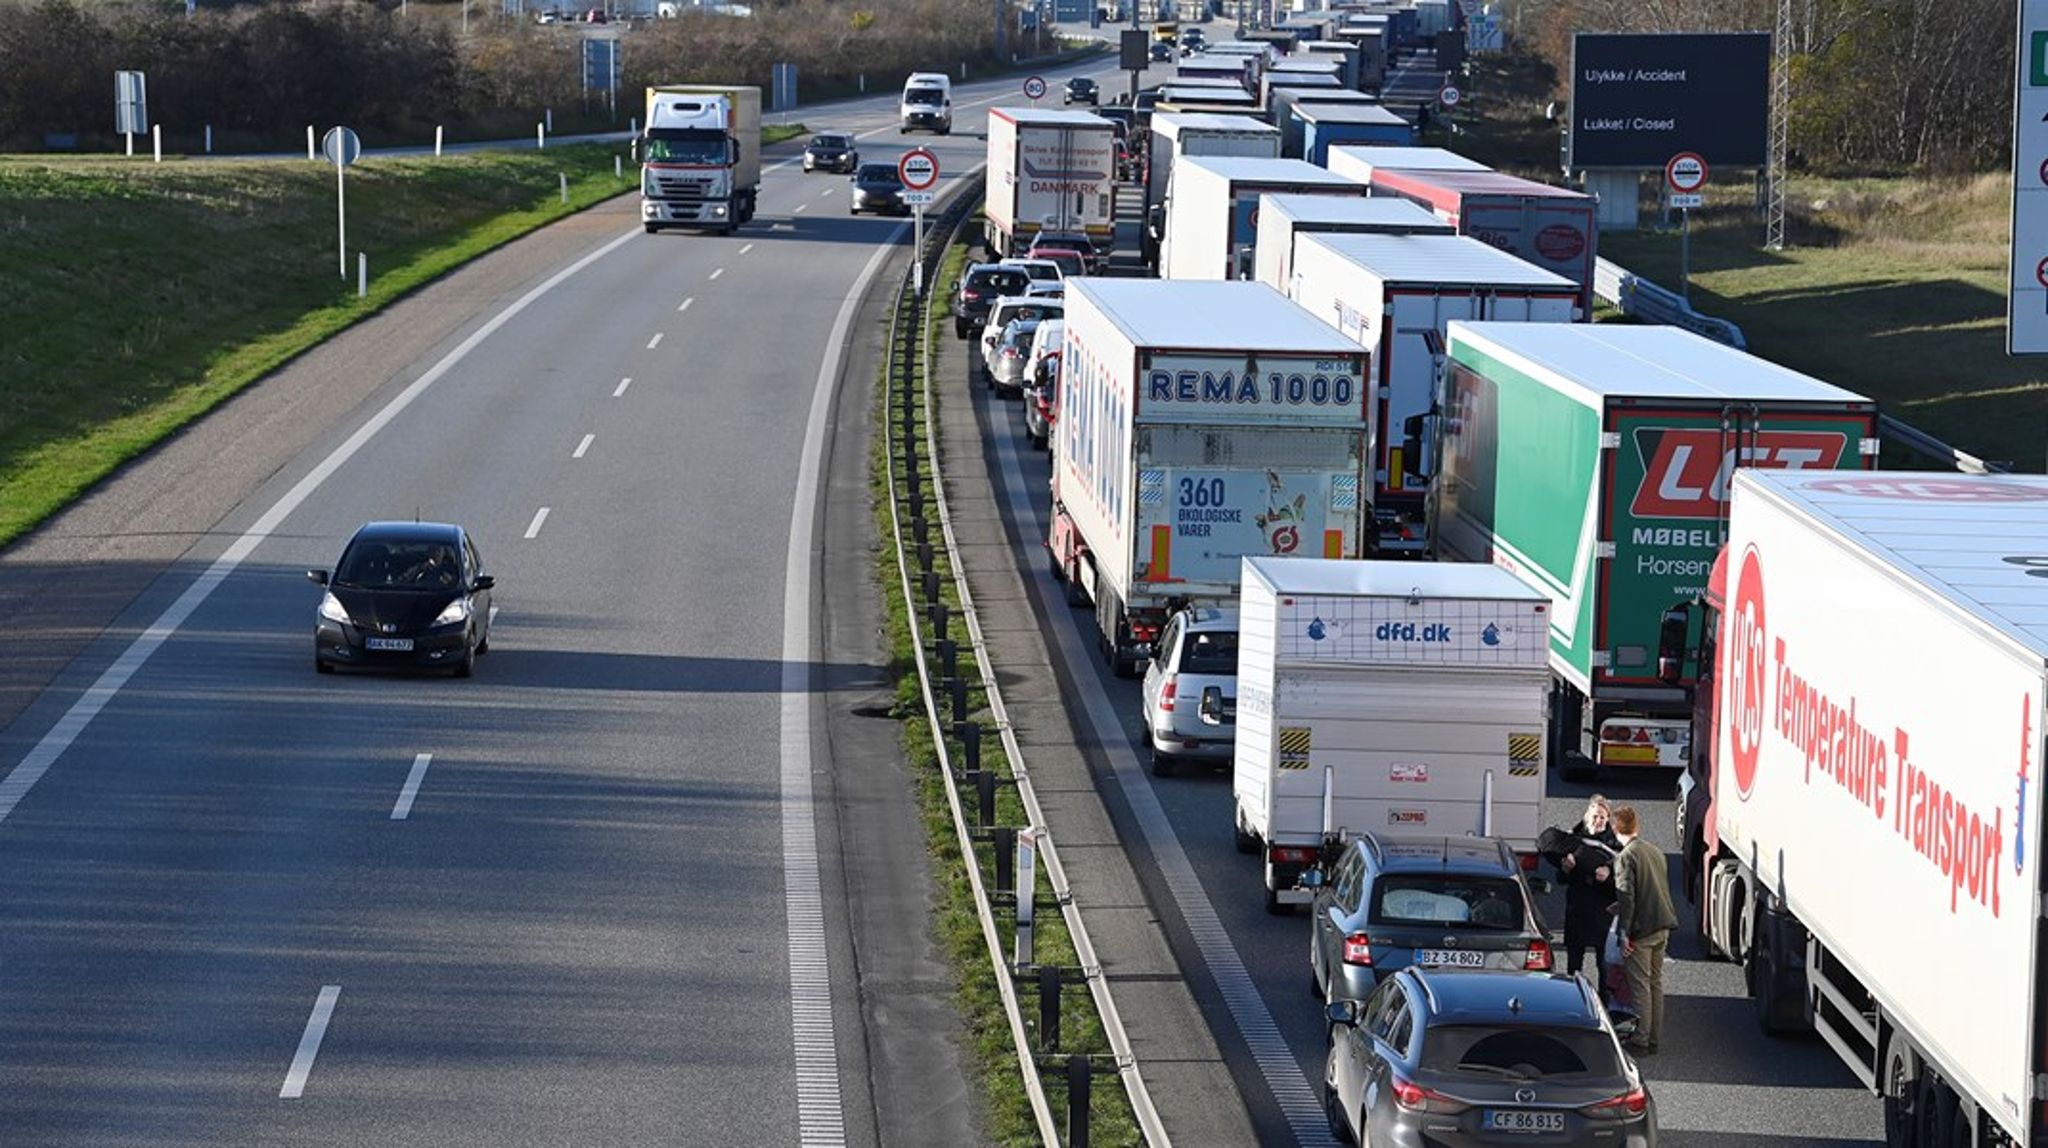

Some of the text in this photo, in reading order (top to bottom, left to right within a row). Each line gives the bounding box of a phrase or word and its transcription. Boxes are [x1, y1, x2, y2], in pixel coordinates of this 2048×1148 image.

[1585, 69, 1625, 84] Ulykke
[1634, 69, 1686, 81] Accident
[1028, 83, 1042, 92] 80
[1584, 118, 1623, 130] Lukket
[1633, 118, 1674, 130] Closed
[908, 160, 930, 168] STOP
[1030, 181, 1099, 194] DANMARK
[1149, 369, 1355, 406] REMA 1000
[1179, 477, 1226, 507] 360
[1178, 508, 1242, 523] ØKOLOGISKE
[1178, 523, 1211, 537] VARER
[1632, 527, 1727, 548] MØBEL
[1637, 555, 1711, 576] Horsen
[1375, 621, 1452, 642] dfd.dk
[1731, 599, 1765, 755] HCS
[1774, 635, 2003, 919] Temperature Transport
[1423, 952, 1483, 965] BZ 34 802
[1494, 1112, 1563, 1129] CF 86 815
